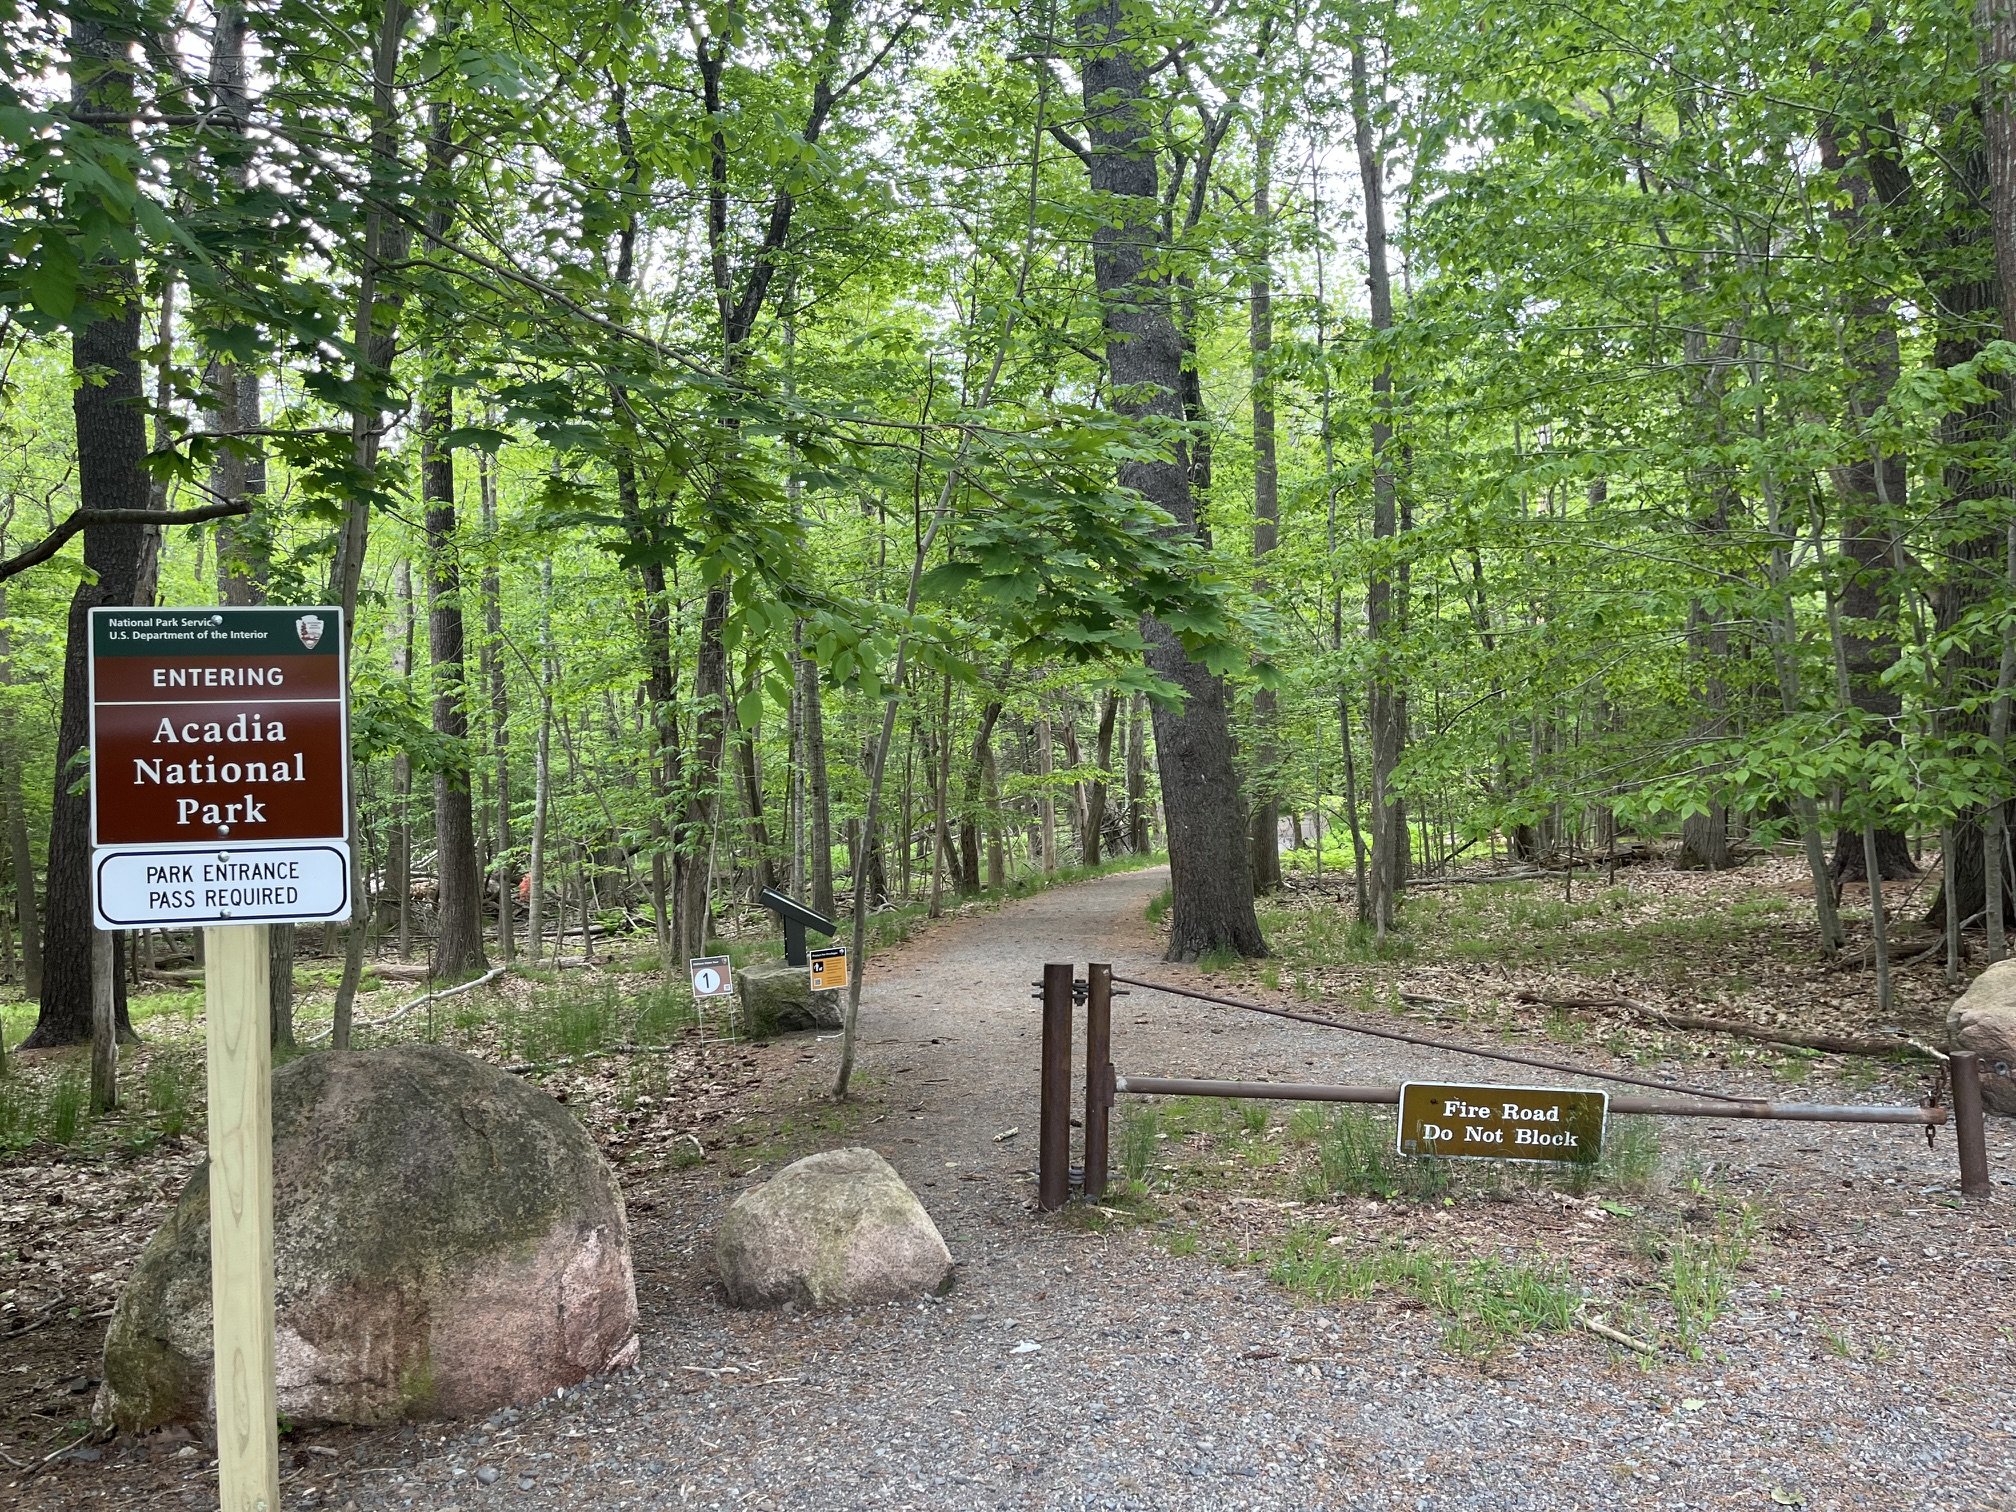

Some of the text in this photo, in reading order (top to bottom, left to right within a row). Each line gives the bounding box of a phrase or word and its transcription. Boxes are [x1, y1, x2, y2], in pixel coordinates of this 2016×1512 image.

[108, 617, 216, 627] National Park Servic
[109, 629, 269, 642] U.S. Department of the Interior
[153, 667, 284, 687] ENTERING
[152, 713, 287, 744] Acadia
[133, 752, 306, 785] National
[176, 794, 267, 825] Park
[146, 861, 300, 884] PARK ENTRANCE
[149, 886, 299, 909] PASS REQUIRED
[702, 972, 710, 989] 1
[1443, 1100, 1560, 1122] Fire Road
[1422, 1124, 1579, 1147] Do Not Block
